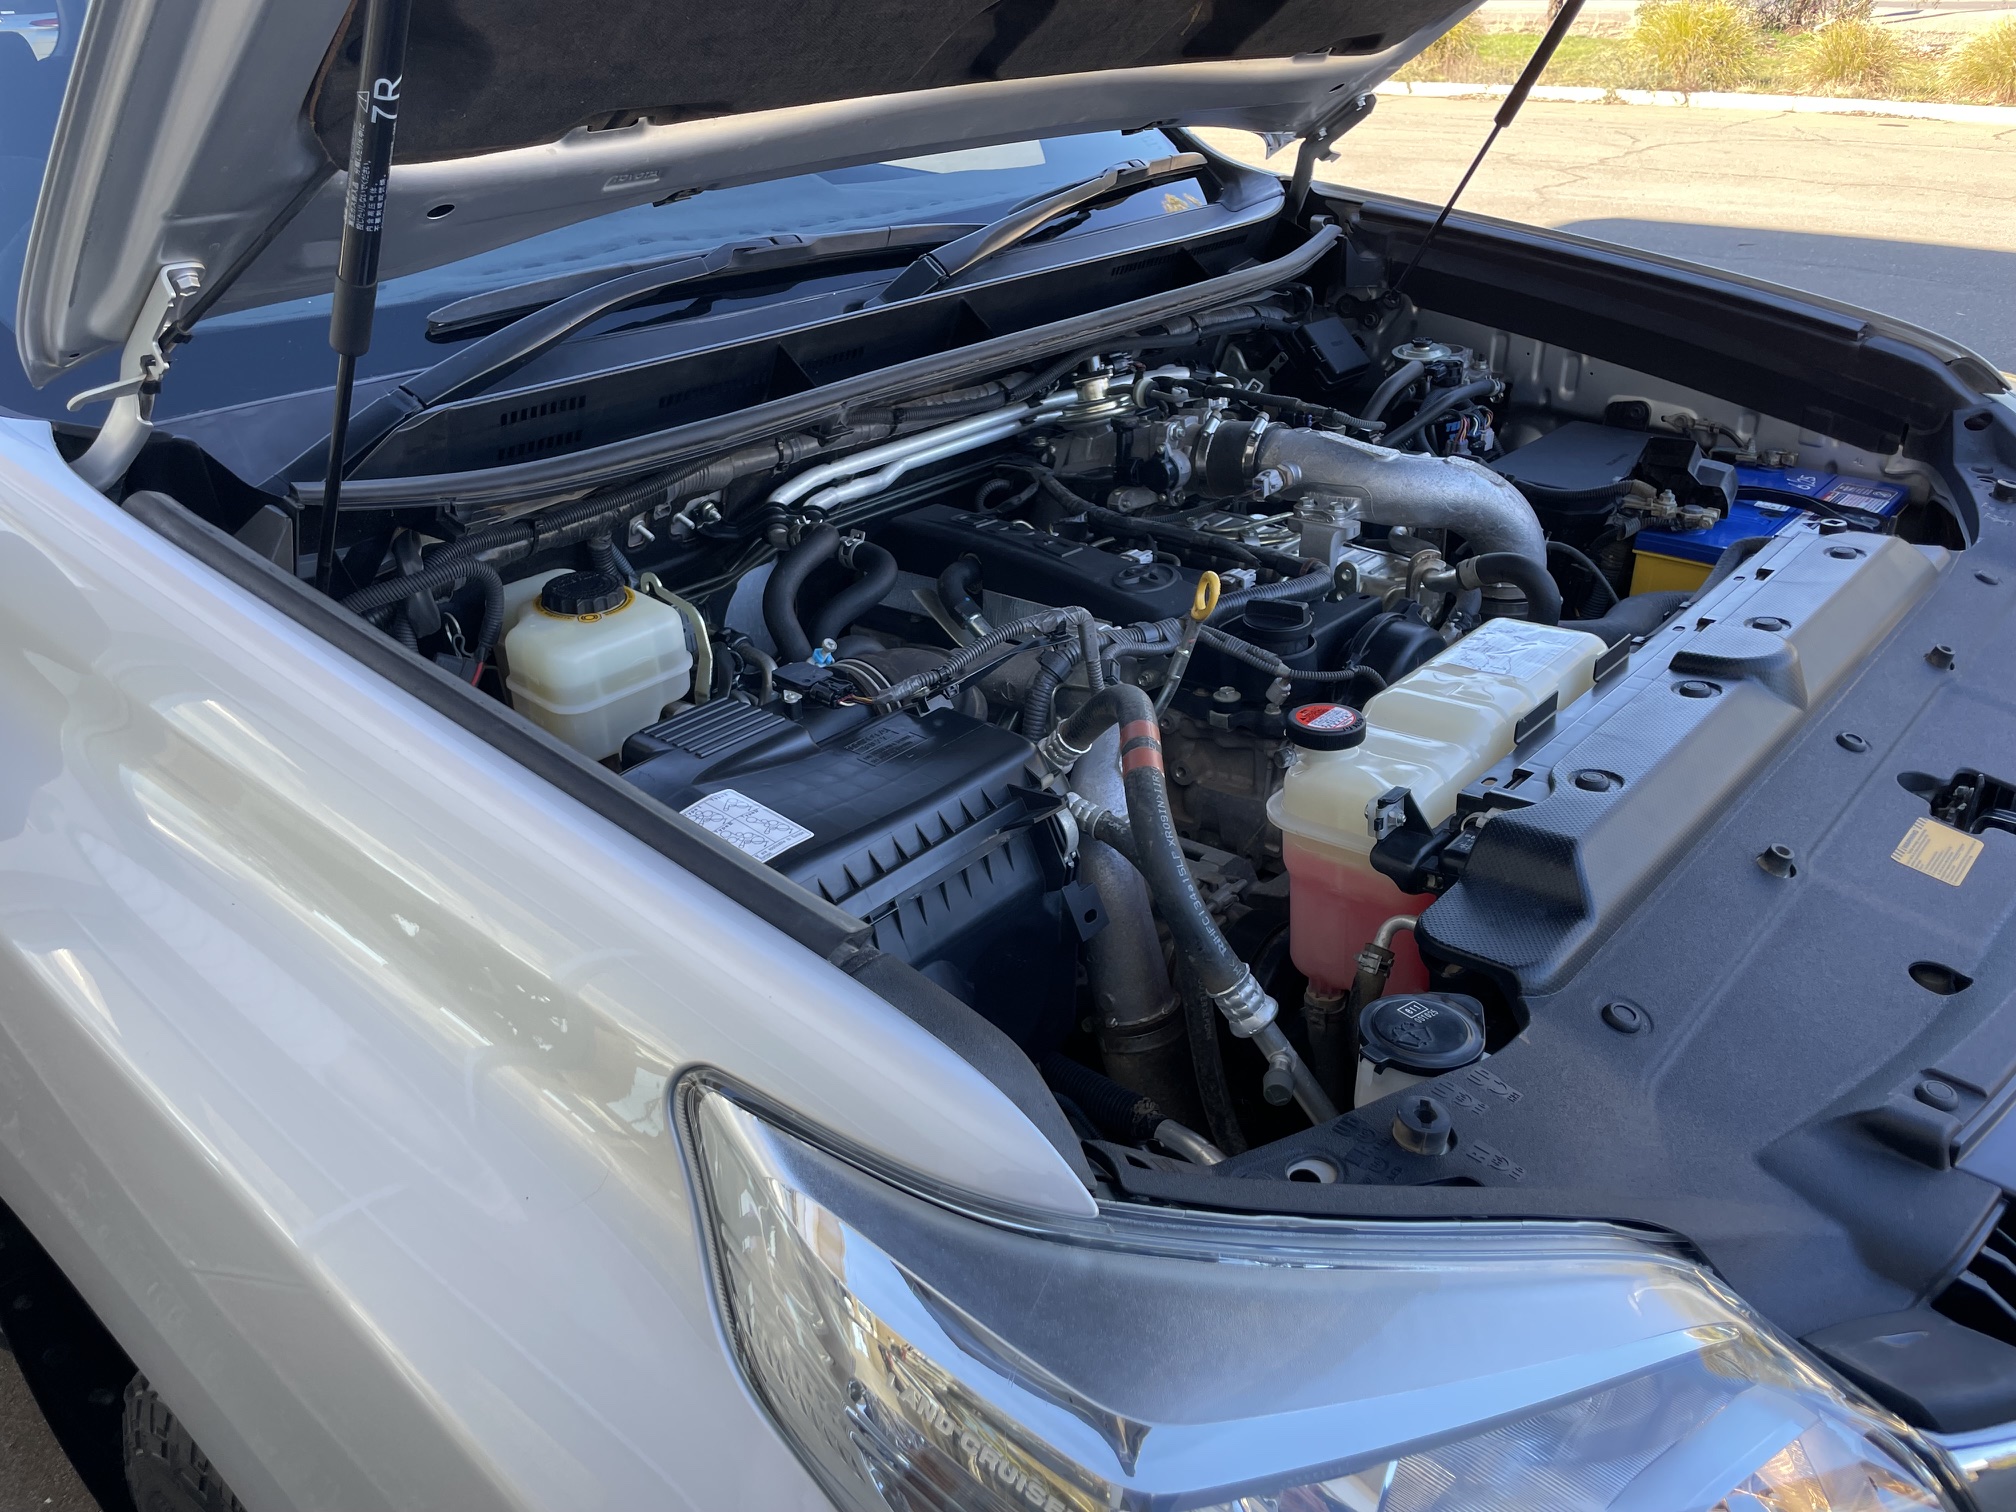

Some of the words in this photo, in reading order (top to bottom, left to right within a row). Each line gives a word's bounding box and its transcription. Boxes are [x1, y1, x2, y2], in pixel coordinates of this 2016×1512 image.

[371, 74, 403, 124] 7R
[887, 1372, 959, 1436] LAND
[960, 1430, 1075, 1512] CRUISE
